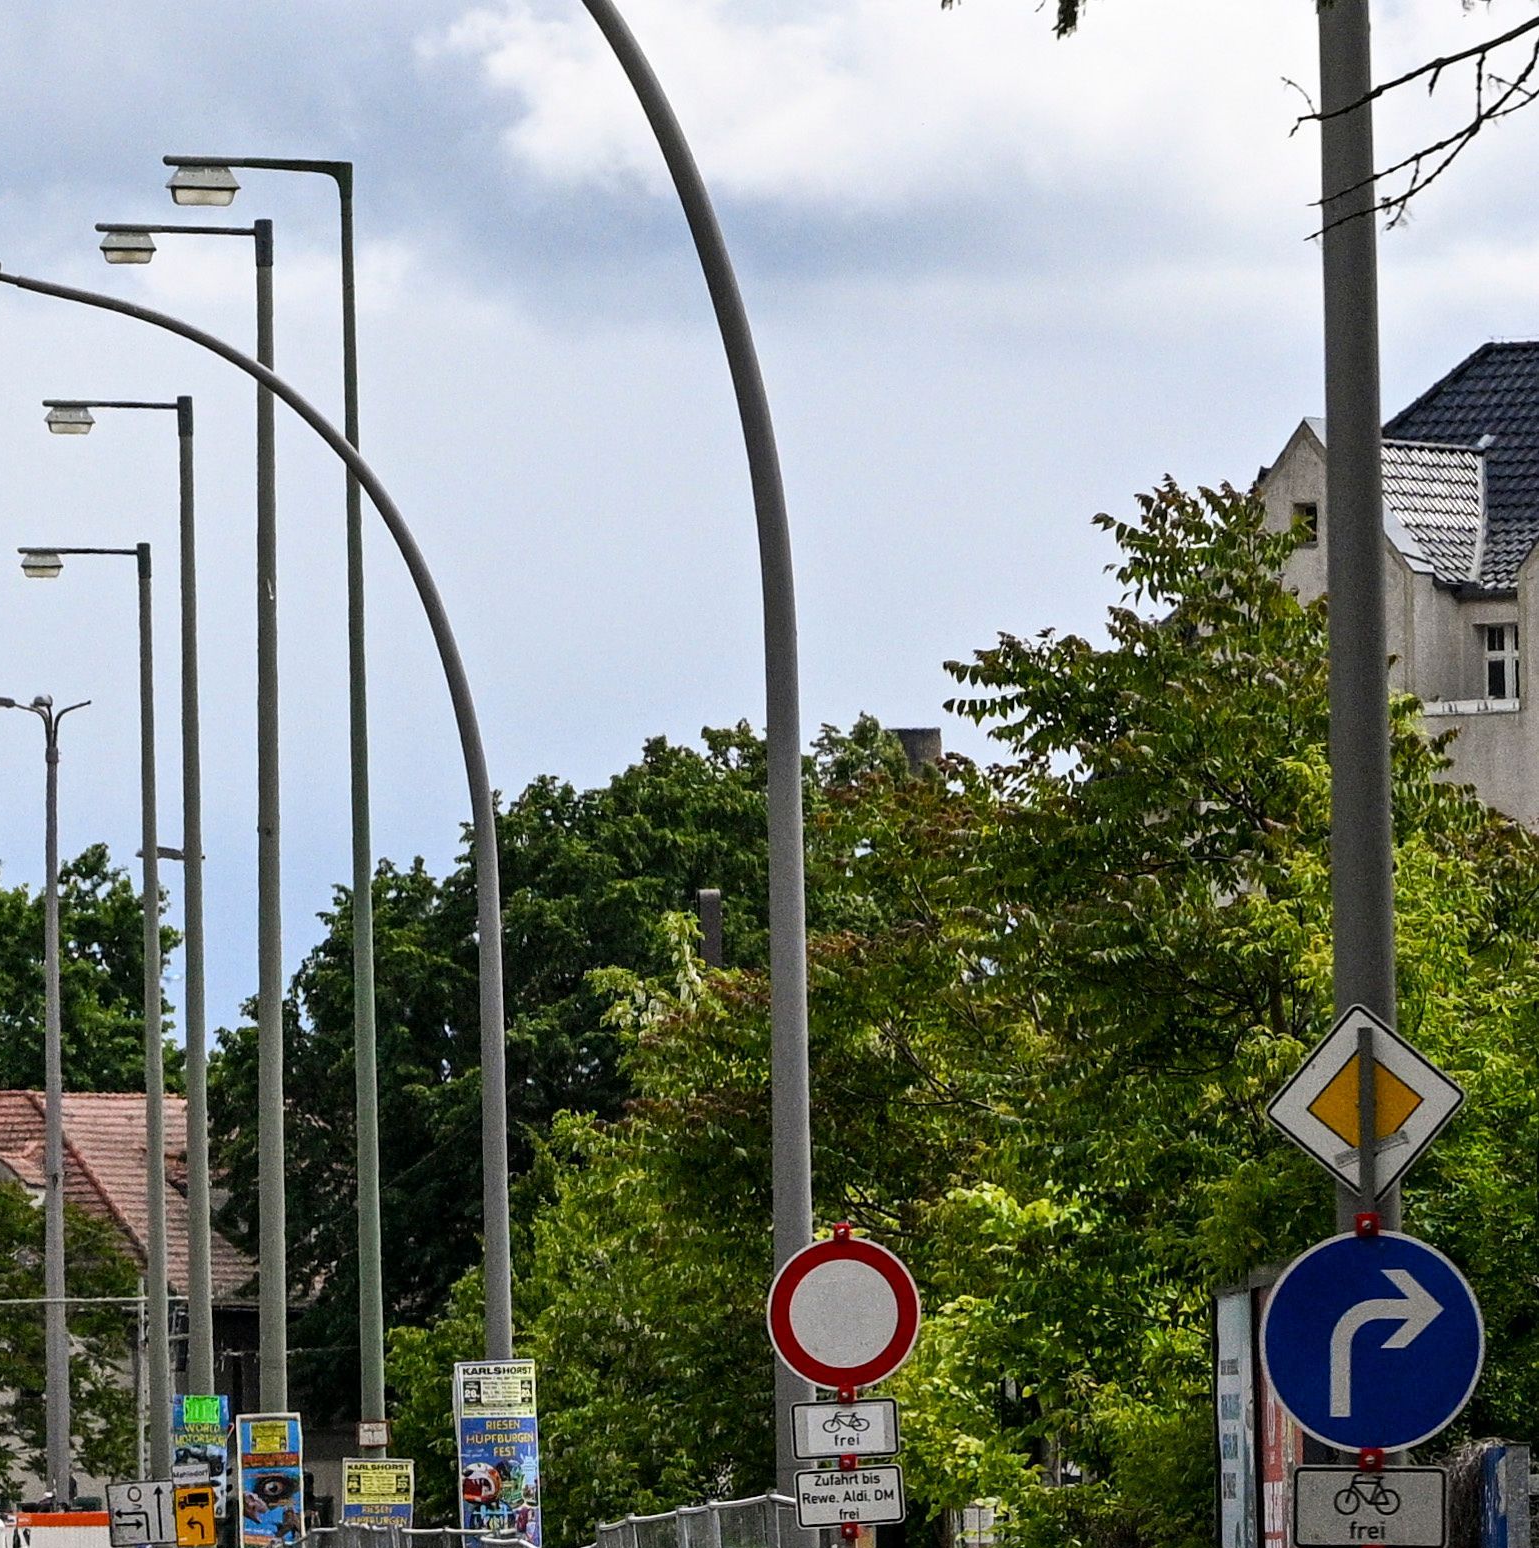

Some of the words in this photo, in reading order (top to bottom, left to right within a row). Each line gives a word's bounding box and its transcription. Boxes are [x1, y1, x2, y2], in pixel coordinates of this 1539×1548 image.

[462, 1366, 532, 1375] KARLSHORST
[485, 1419, 520, 1430] RIESEN
[834, 1433, 860, 1446] frei
[493, 1446, 516, 1457] FEST
[347, 1463, 409, 1471] KARLSHORST
[814, 1474, 858, 1487] Zufahrt
[862, 1473, 881, 1485] bis
[874, 1489, 895, 1502] DM
[839, 1508, 860, 1520] frei
[1349, 1521, 1386, 1540] frei
